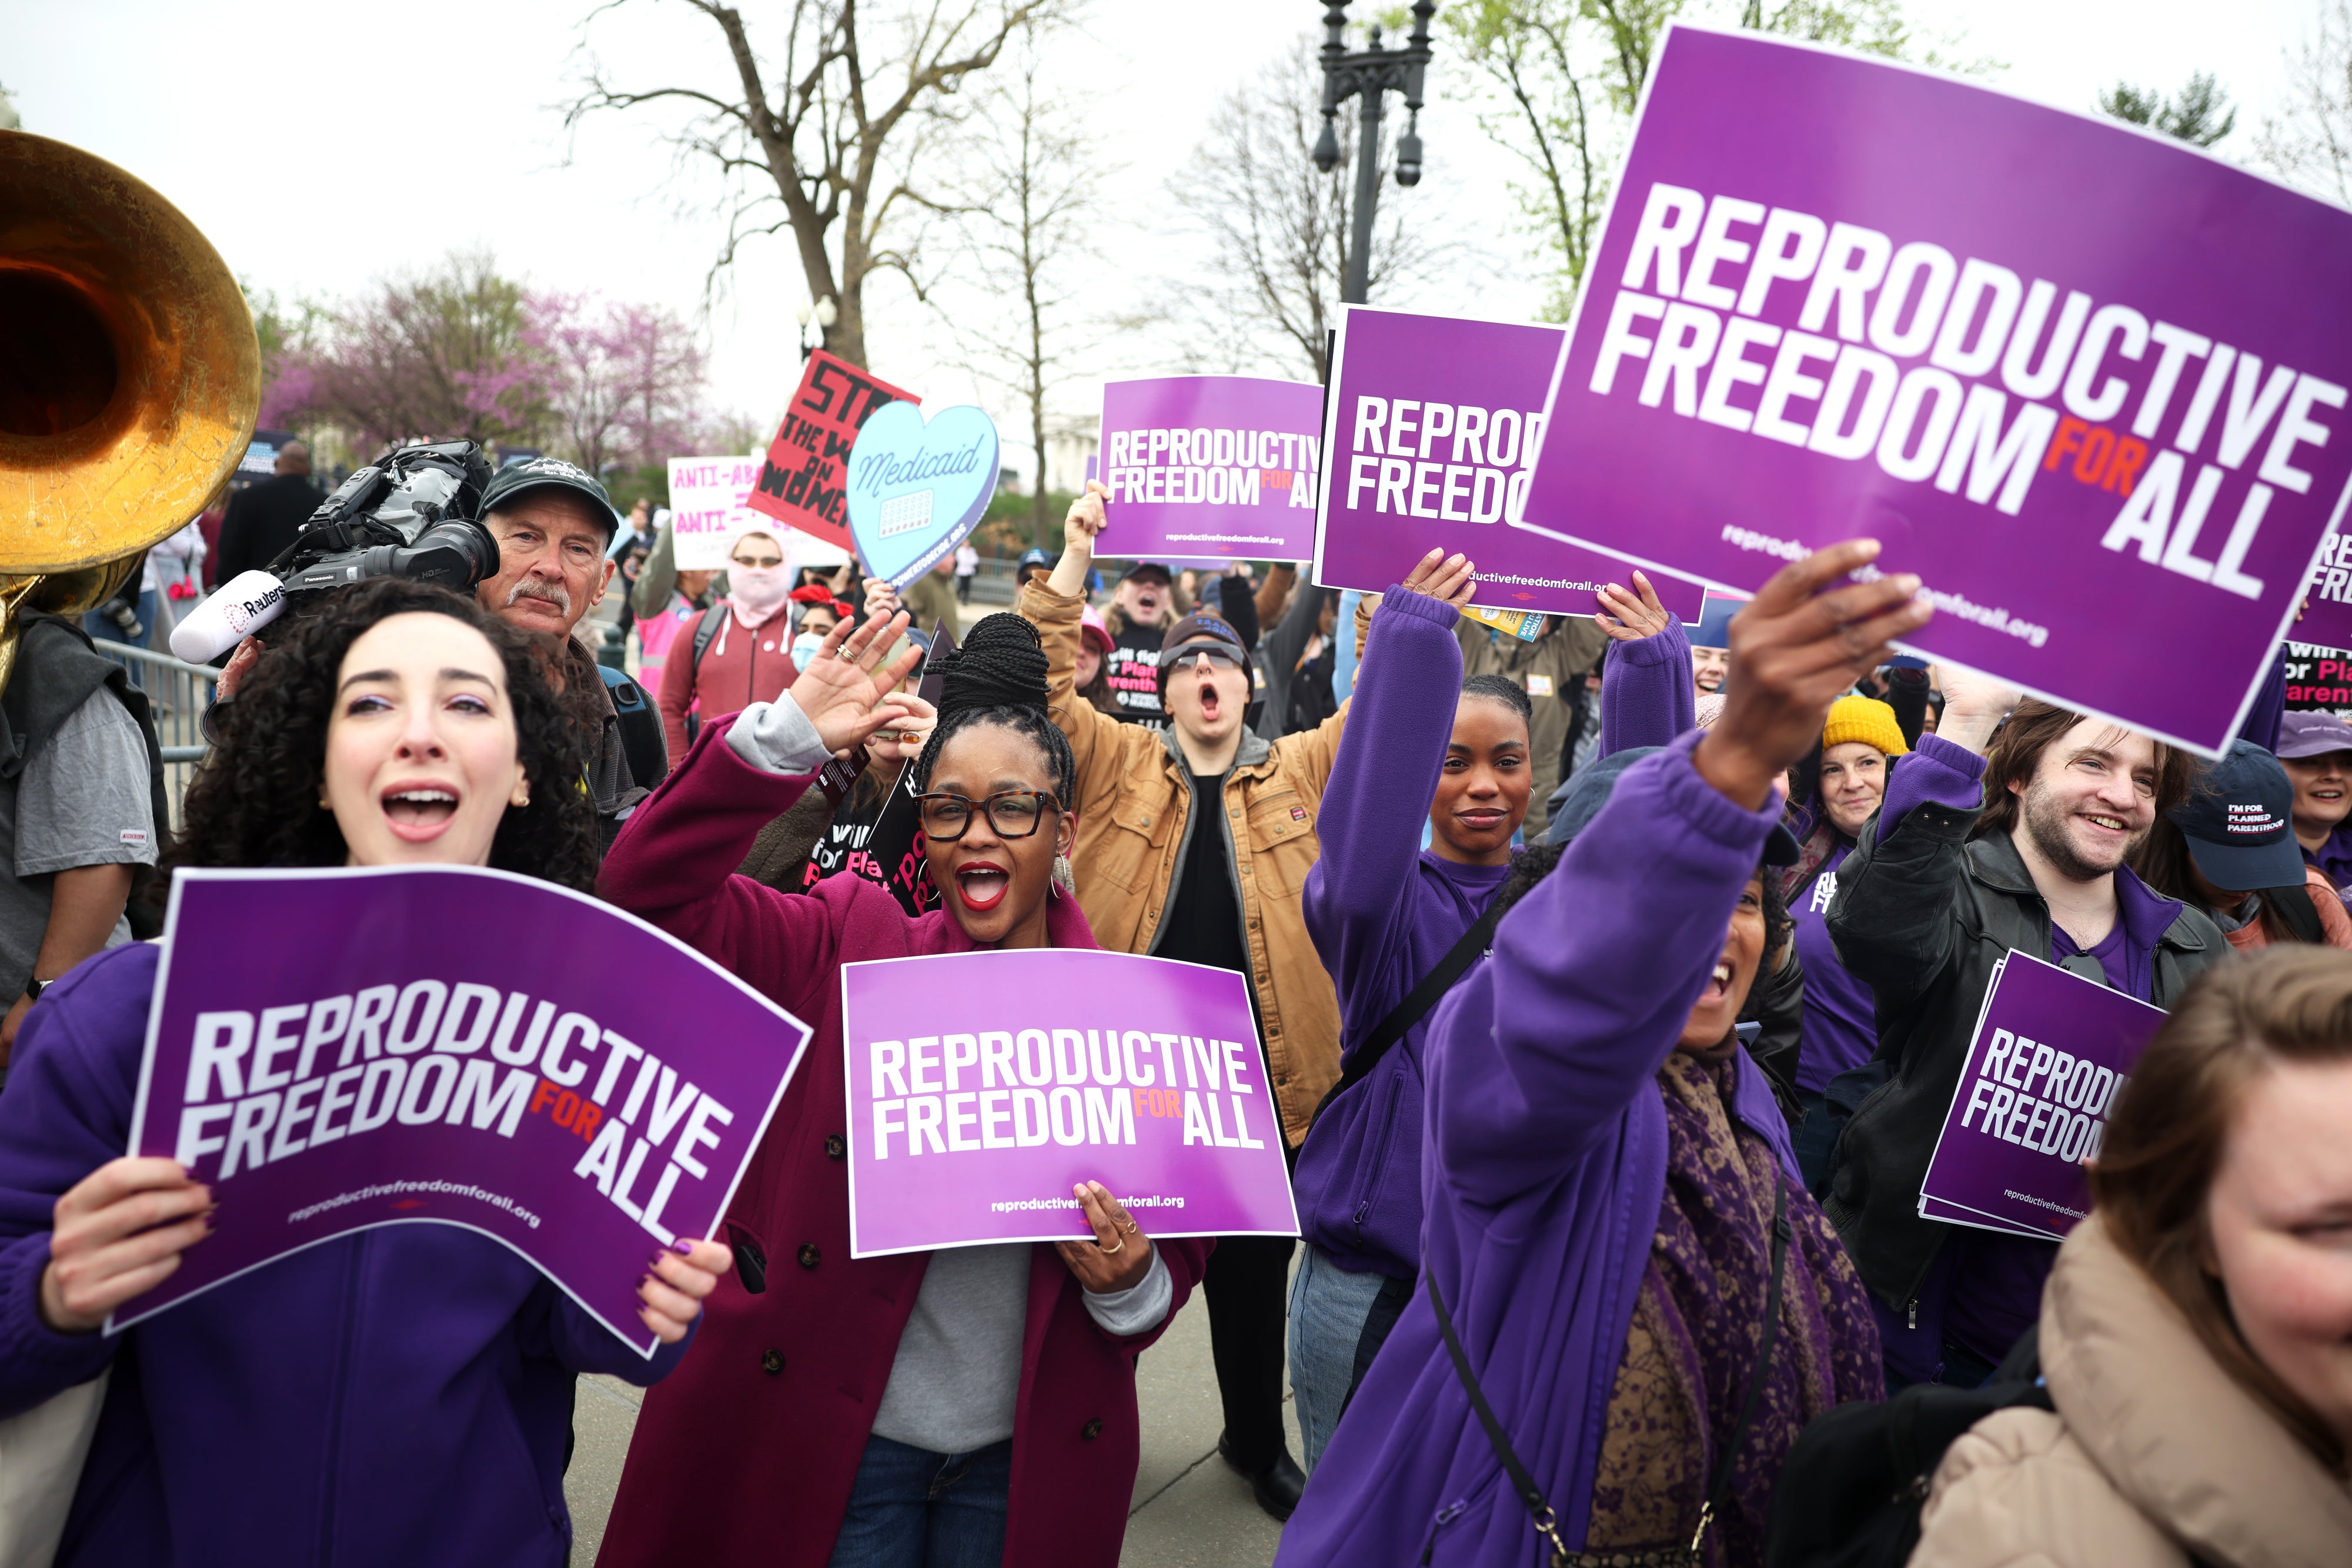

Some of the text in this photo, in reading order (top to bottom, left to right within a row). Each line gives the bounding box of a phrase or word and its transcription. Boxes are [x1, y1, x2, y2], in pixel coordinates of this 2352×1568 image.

[1621, 181, 2350, 495] REPRODUCTIVE
[781, 413, 824, 453] THE
[1109, 427, 1321, 473] REPRODUCTIV
[1589, 289, 2275, 601] FREEDOM FOR ALL
[804, 455, 834, 482] ON
[857, 433, 985, 498] Medicaid
[1107, 466, 1260, 506] FREEDOM
[1261, 469, 1292, 490] FOR
[1165, 532, 1284, 546] reproductivefreedomforall.org
[304, 574, 335, 582] Panasonic
[1468, 570, 1609, 593] ductivefreedomforall.or
[243, 584, 285, 618] Reuters
[1520, 620, 1532, 637] LIVE
[1528, 613, 1544, 636] ATION
[2227, 819, 2284, 832] PARENTHOOD
[2228, 813, 2271, 823] PLANNED
[2229, 804, 2263, 813] I'M FOR
[811, 837, 843, 870] for
[183, 979, 735, 1181] REPRODUCTIVE
[870, 1028, 1254, 1099] REPRODUCTIVE
[872, 1086, 1265, 1161] FREEDOM FOR ALL
[175, 1054, 684, 1248] FREEDOM FOR ALL
[288, 1179, 542, 1229] reproductivefreedomforall.org
[991, 1195, 1185, 1213] reproductivefmforall.org
